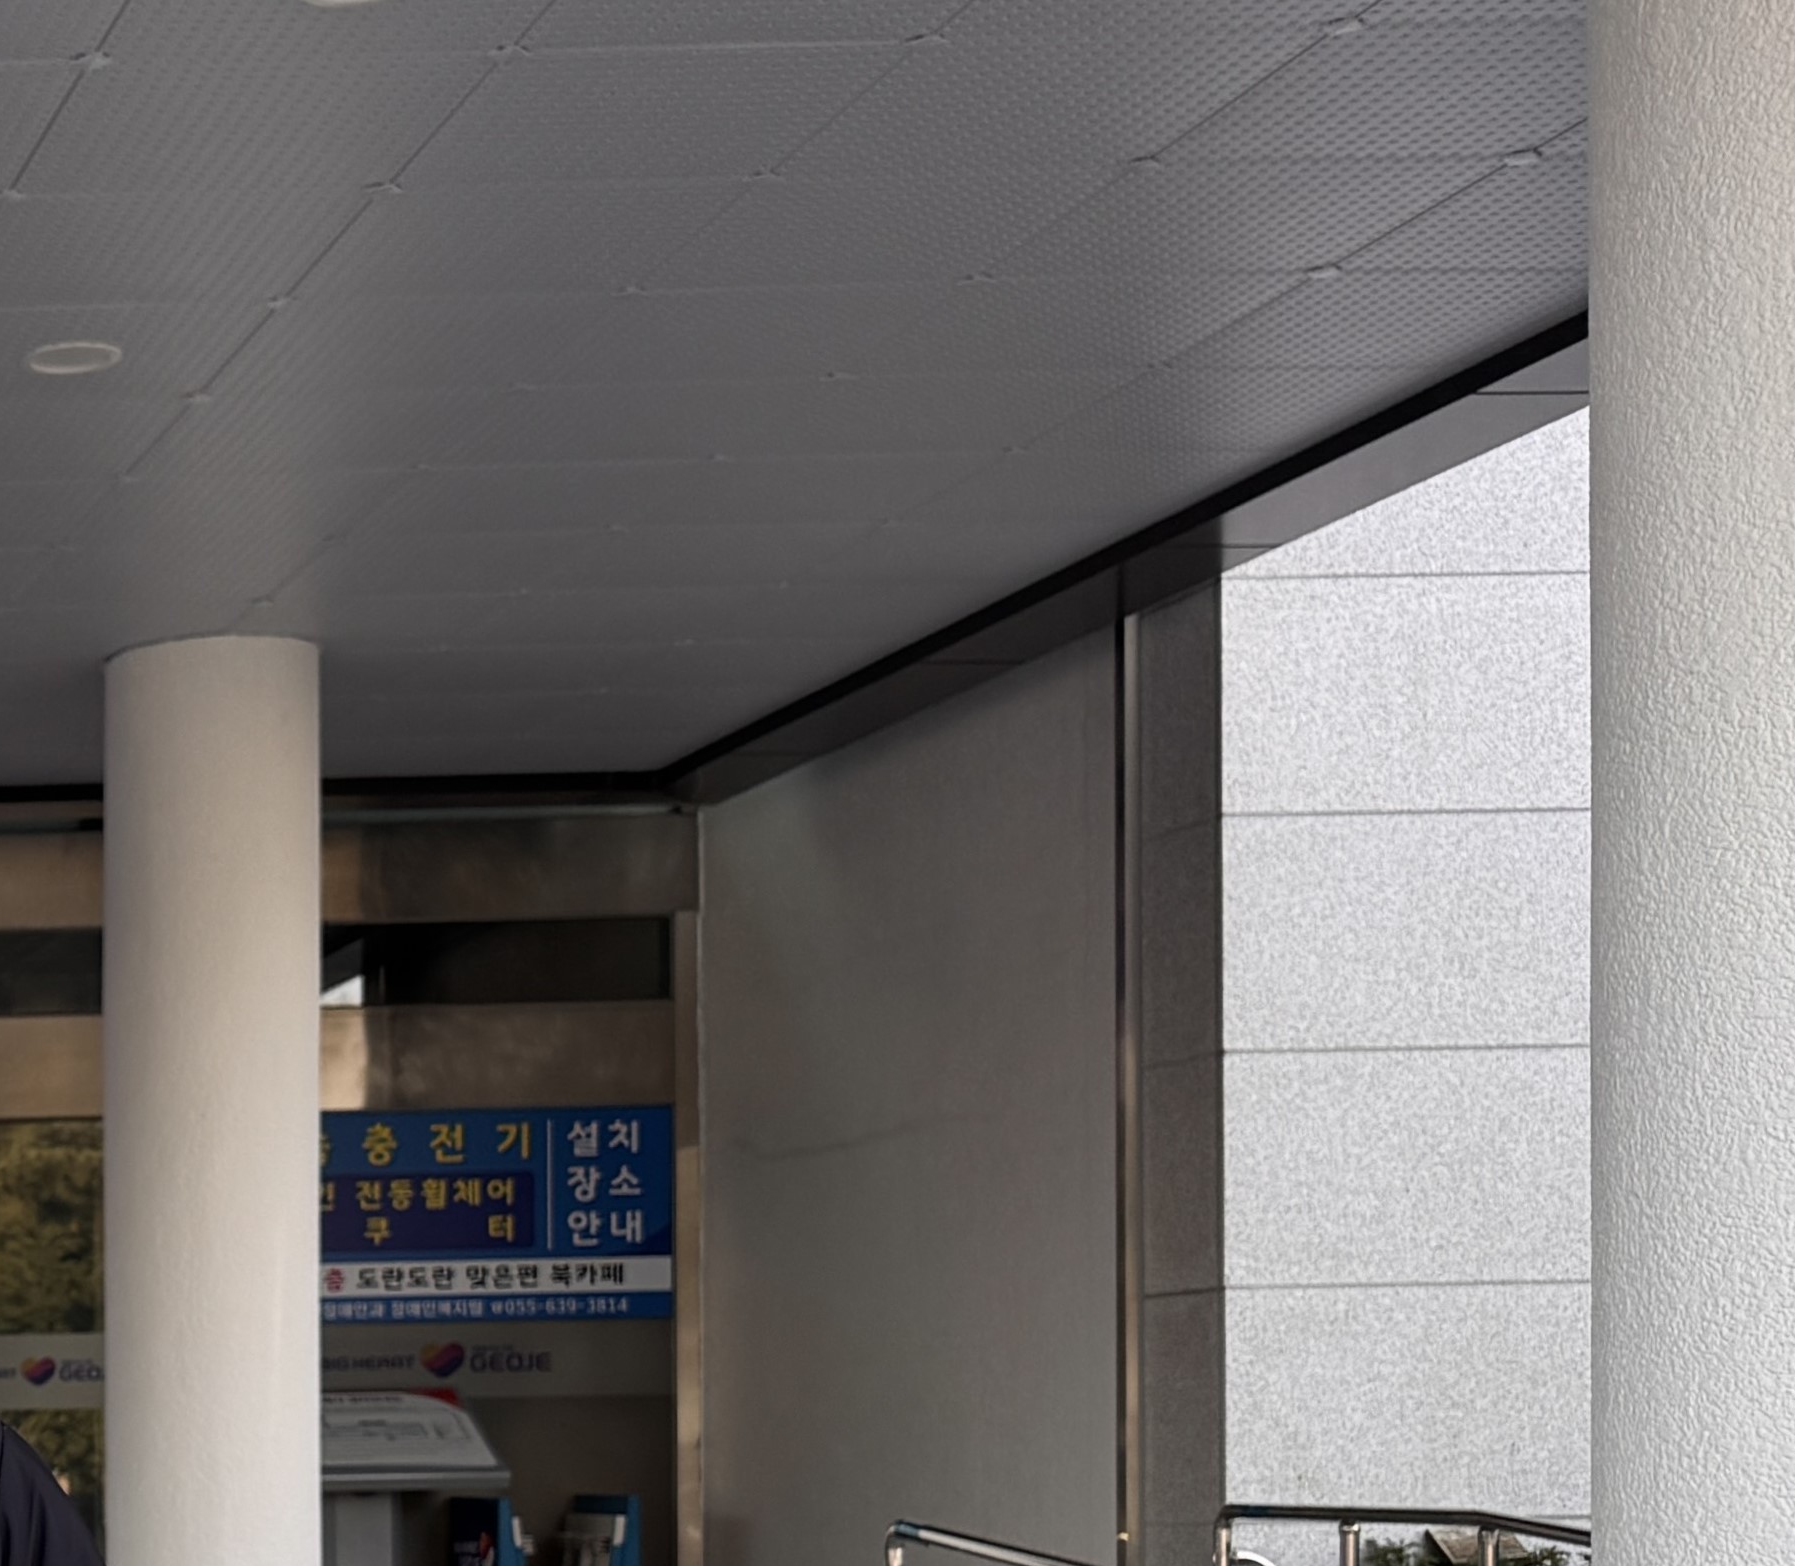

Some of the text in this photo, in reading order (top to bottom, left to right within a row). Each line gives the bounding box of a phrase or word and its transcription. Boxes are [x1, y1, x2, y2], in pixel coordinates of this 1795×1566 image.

[567, 1119, 642, 1158] 설치
[355, 1177, 516, 1212] 전동휠체어
[567, 1165, 642, 1202] 장소
[567, 1209, 646, 1248] 안내
[356, 1265, 455, 1291] 도란도란
[465, 1263, 539, 1289] 맞은편
[550, 1263, 625, 1288] 북카페
